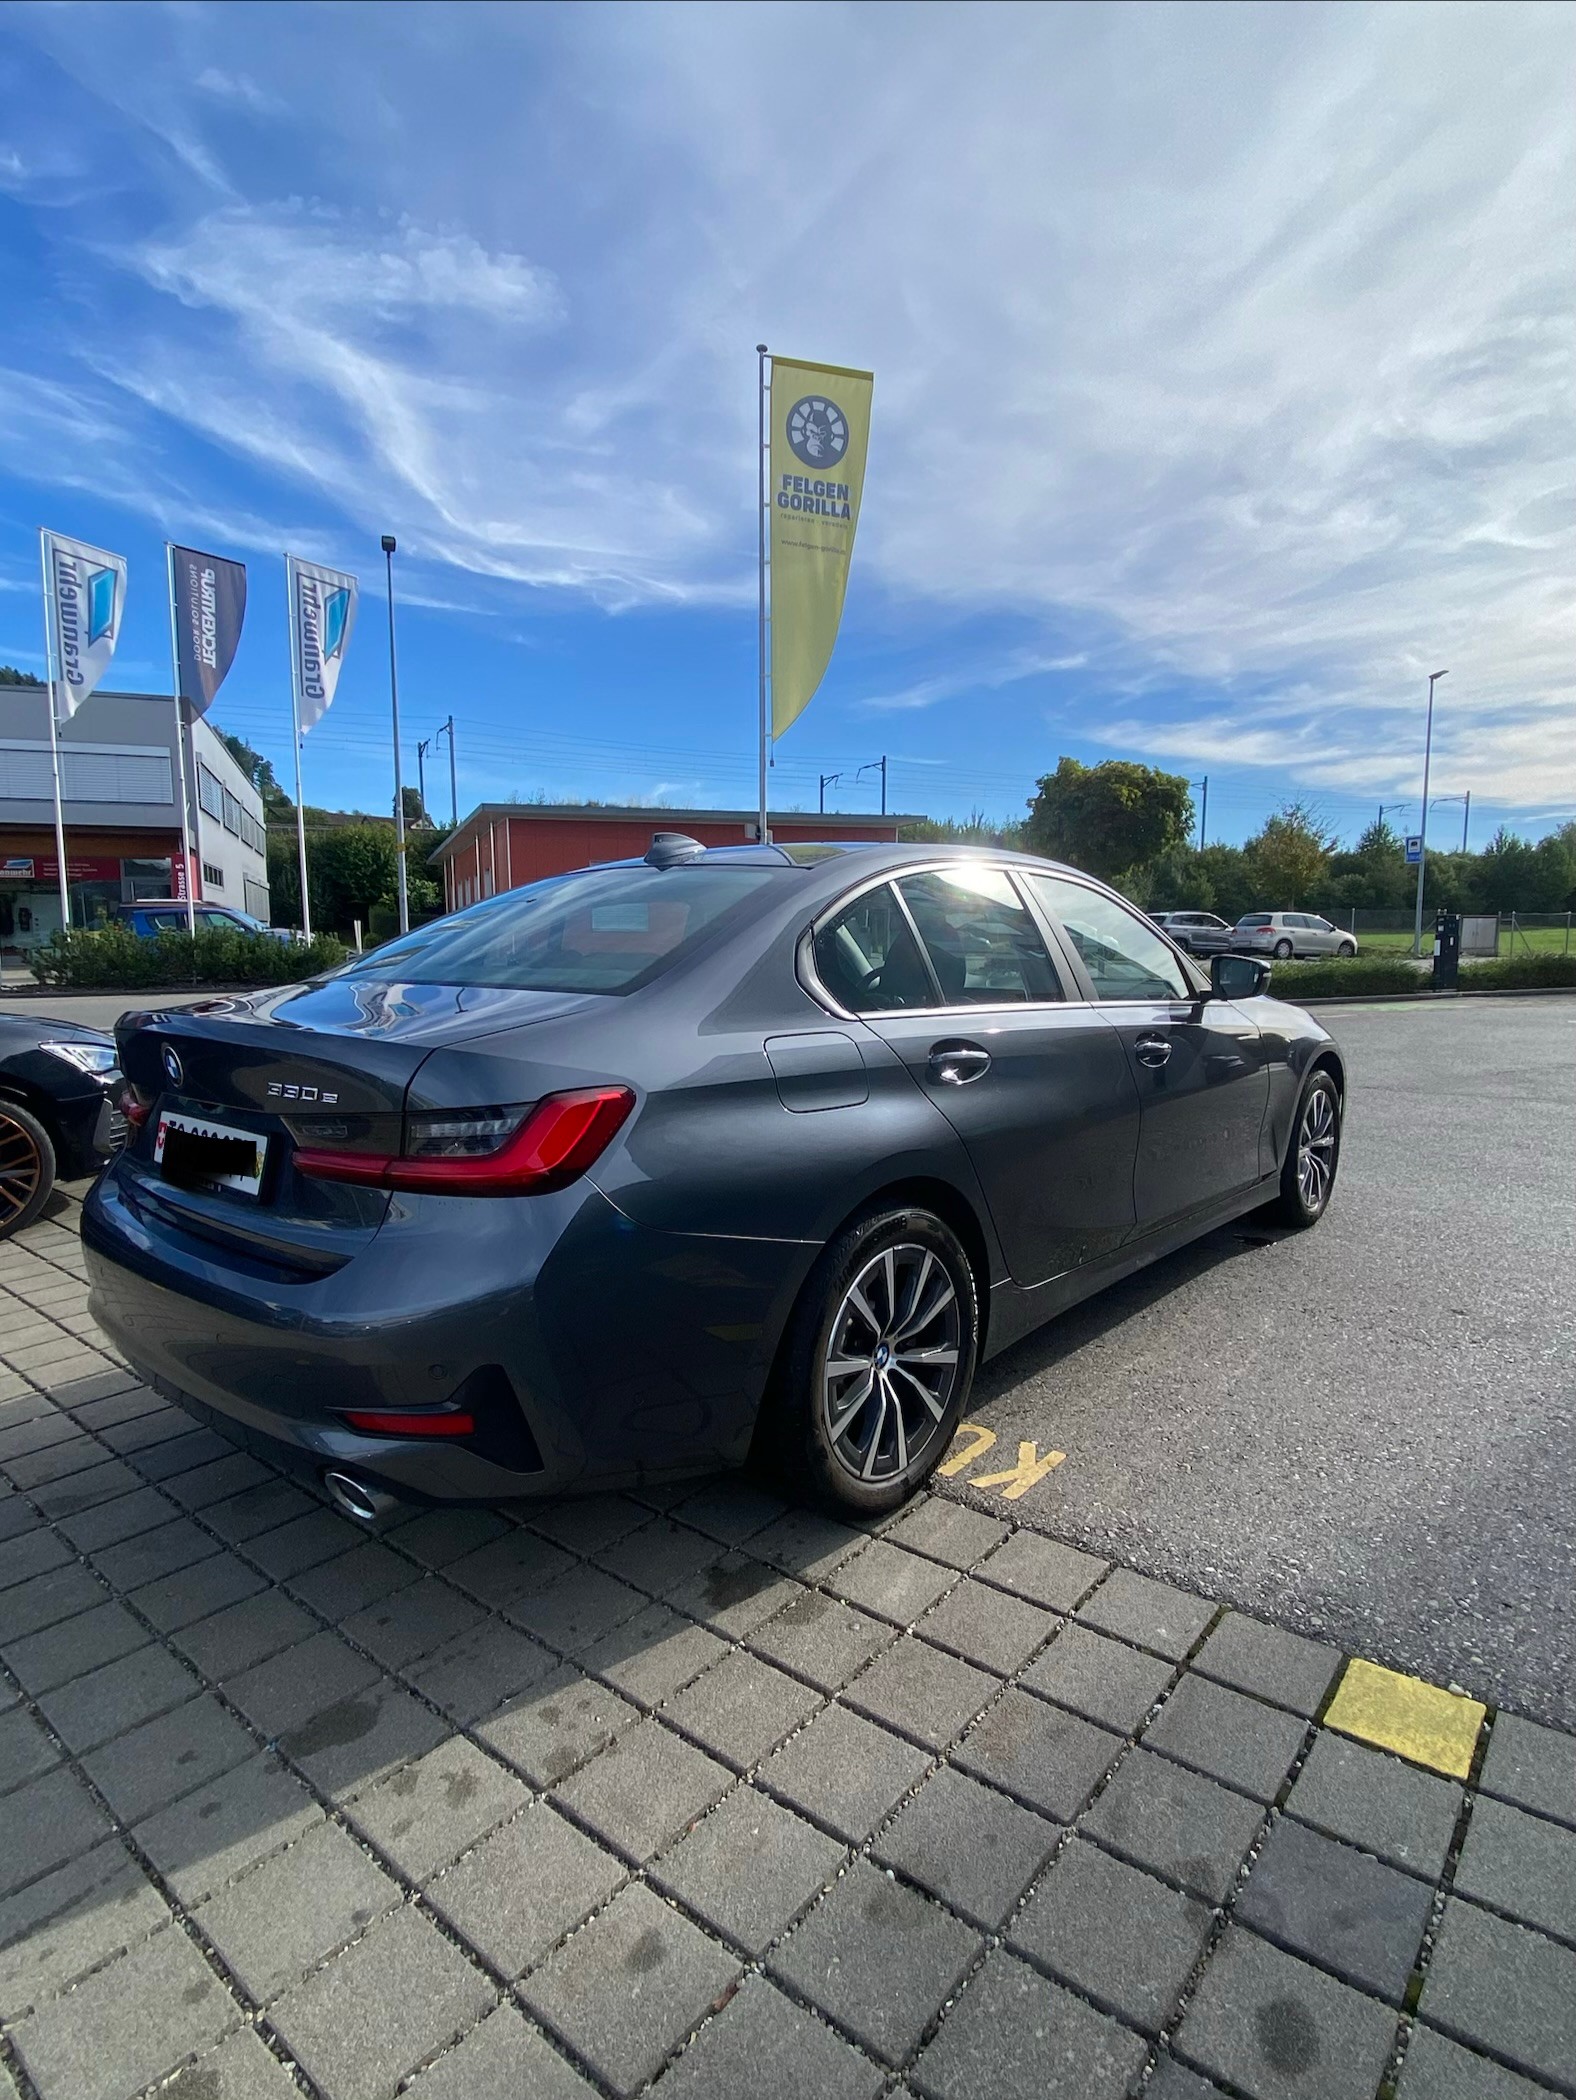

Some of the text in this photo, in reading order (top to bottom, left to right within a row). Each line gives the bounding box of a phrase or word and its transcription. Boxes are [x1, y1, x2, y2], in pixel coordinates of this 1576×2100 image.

[782, 473, 849, 501] FELGEN
[777, 491, 851, 521] GORILLA
[177, 871, 187, 901] Strasse
